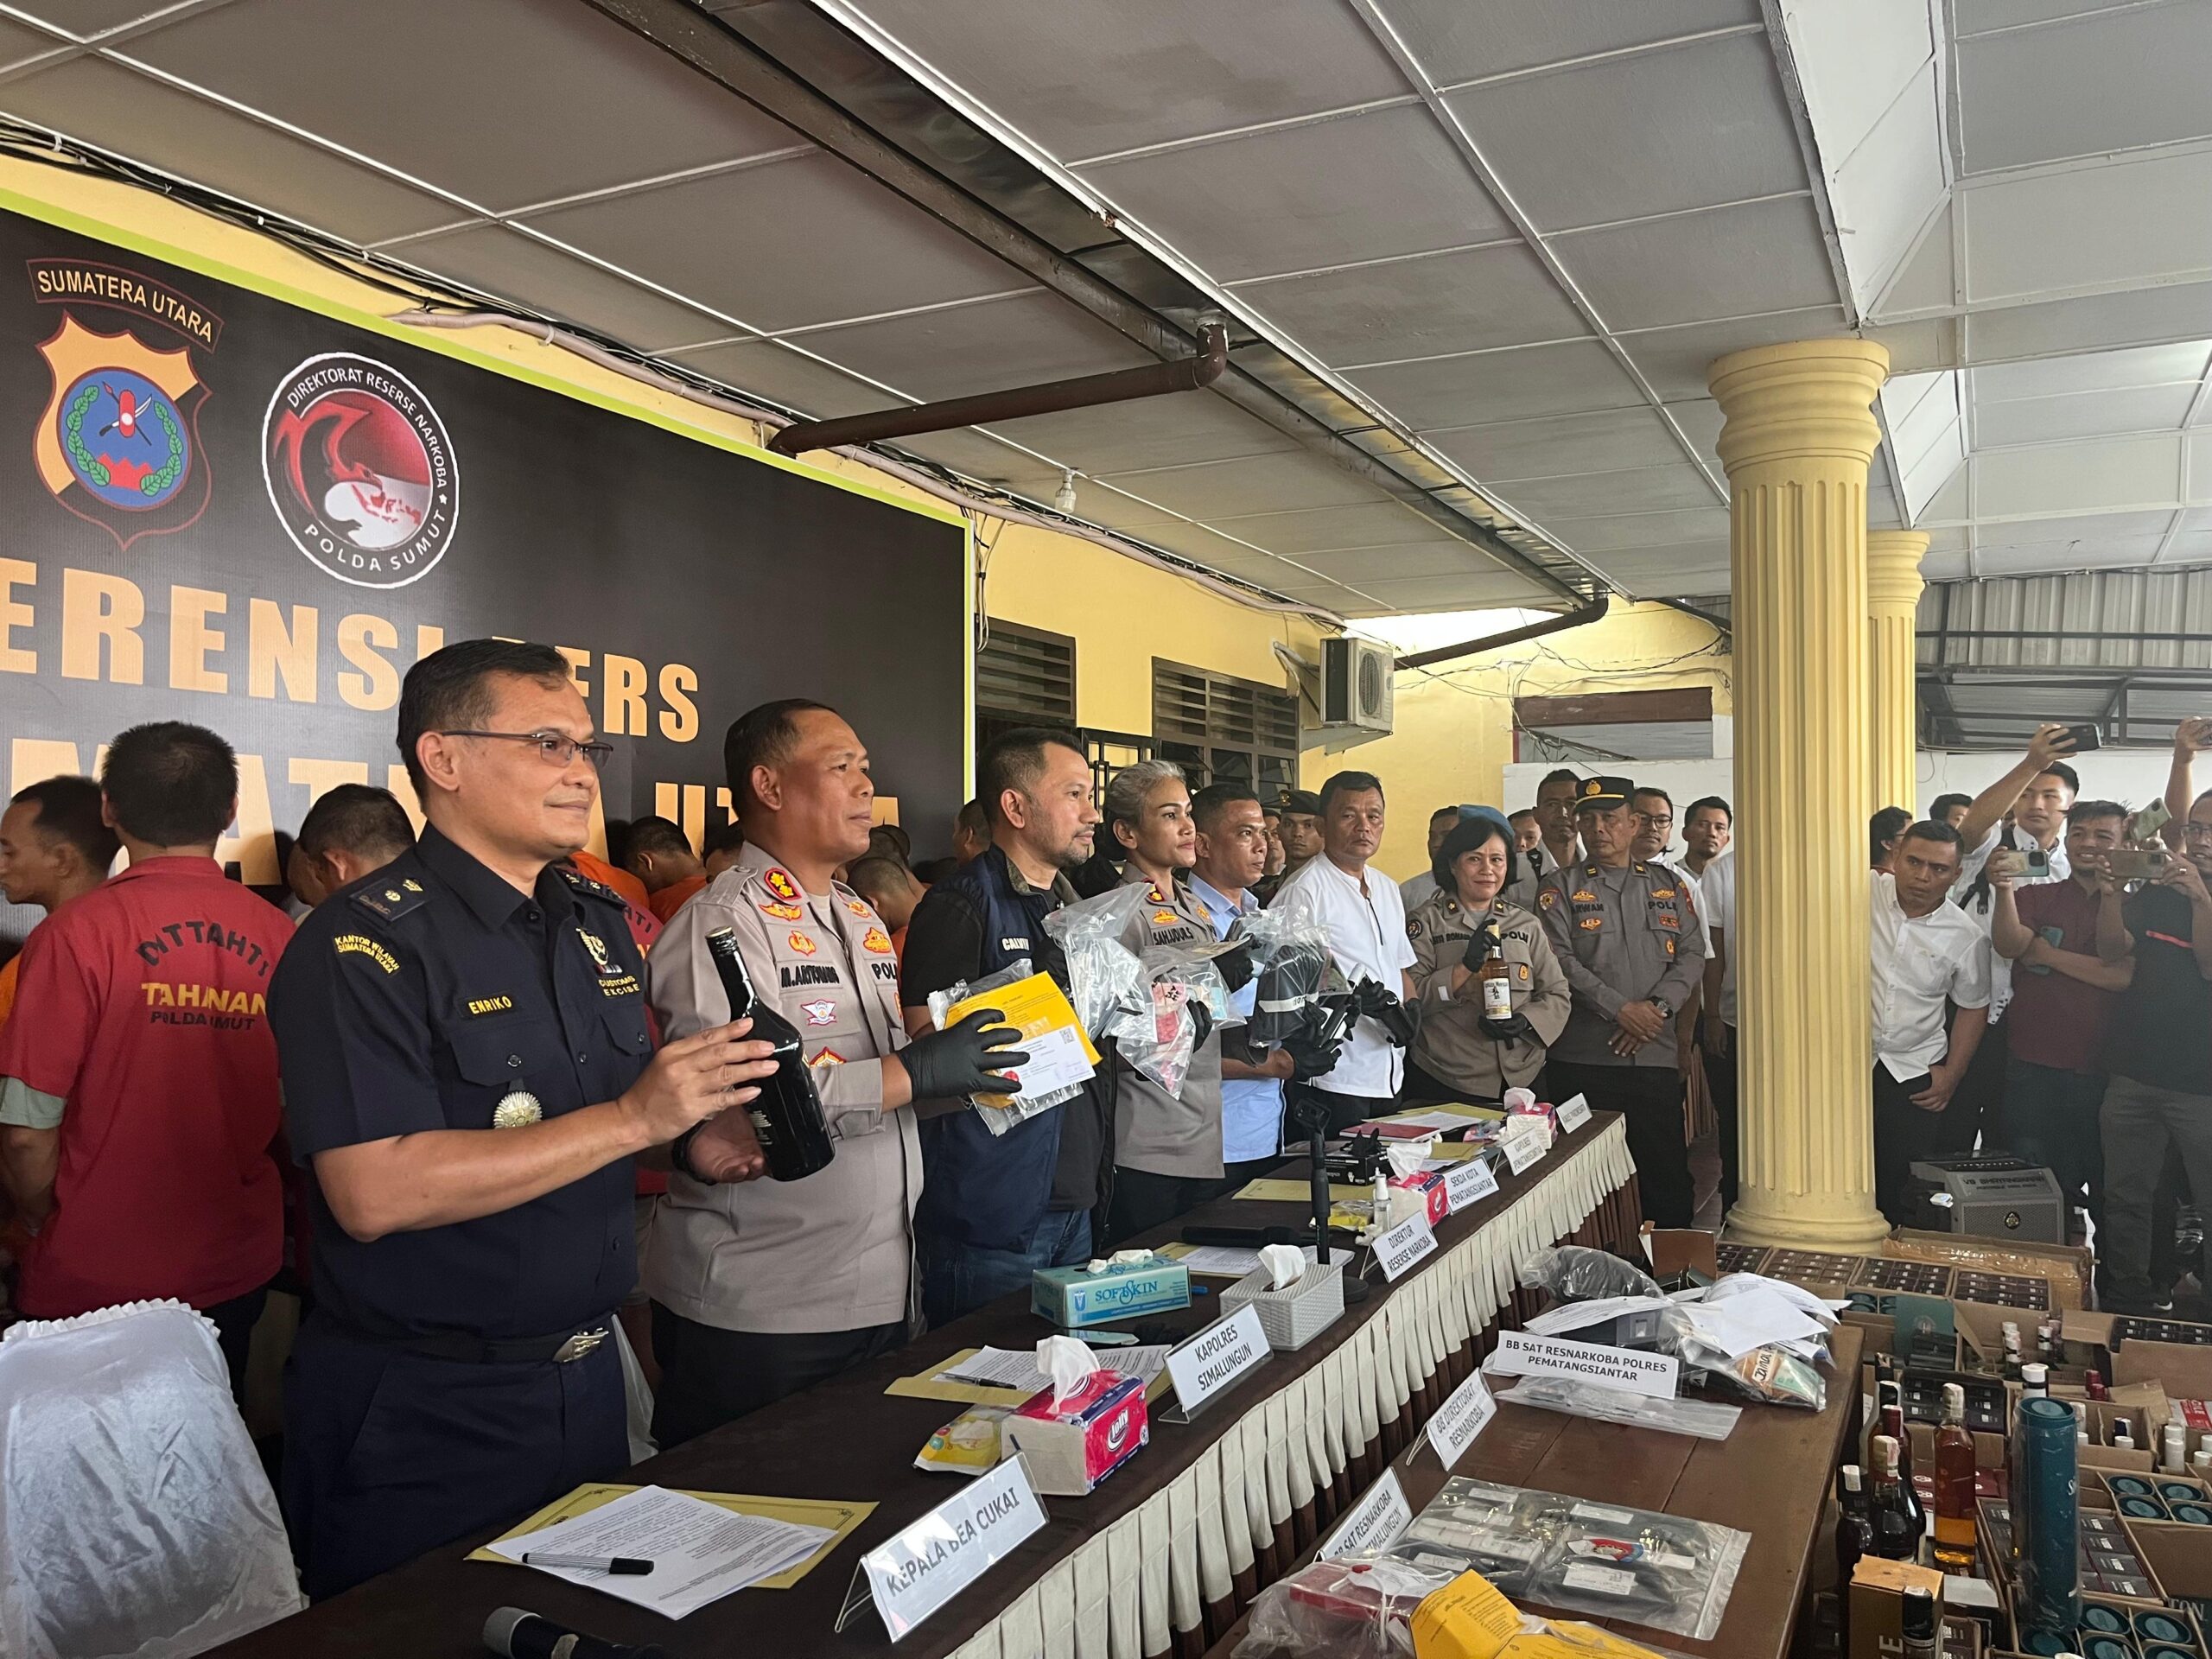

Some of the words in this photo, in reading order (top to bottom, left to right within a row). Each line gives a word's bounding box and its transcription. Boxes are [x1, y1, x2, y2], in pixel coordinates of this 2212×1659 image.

[36, 270, 147, 308] SUMATERA
[151, 296, 213, 343] UTARA
[287, 366, 365, 409] DIREKTORAT
[365, 372, 417, 416] RESERSE
[414, 413, 448, 489] NARKOBA
[304, 523, 381, 572] POLDA
[390, 510, 447, 571] SUMUT
[0, 557, 443, 711] ERENS
[334, 934, 371, 946] KANTOR
[372, 941, 400, 970] WILAYAH
[598, 976, 636, 988] CUSTOMS
[603, 983, 640, 996] EXCISE
[468, 995, 512, 1014] ENRIKO
[1449, 1178, 1494, 1205] PEMATANGSIANTAR
[1387, 1249, 1412, 1273] RESERSE
[1408, 1234, 1433, 1258] NARKOBA
[1388, 1224, 1415, 1249] DIREKTUR
[1194, 1324, 1238, 1363] KAPOLRES
[1505, 1339, 1520, 1350] BB
[1522, 1342, 1543, 1354] SAT
[1545, 1345, 1620, 1366] RESNARKOBA
[1623, 1357, 1667, 1373] POLRES
[1198, 1342, 1253, 1391] SIMALUNGUN
[1528, 1355, 1637, 1382] PEMATANGSIANTAR
[1110, 1409, 1129, 1436] Jolly
[1435, 1414, 1446, 1434] BB
[1443, 1382, 1476, 1426] DIREKTORAT
[1449, 1404, 1485, 1449] RESNARKOBA
[1344, 1530, 1357, 1550] SAT
[1355, 1489, 1393, 1541] RESNARKOBA
[1365, 1506, 1403, 1551] IMALUNGUN
[886, 1540, 949, 1597] KEPALA
[976, 1486, 1020, 1530] CUKAI
